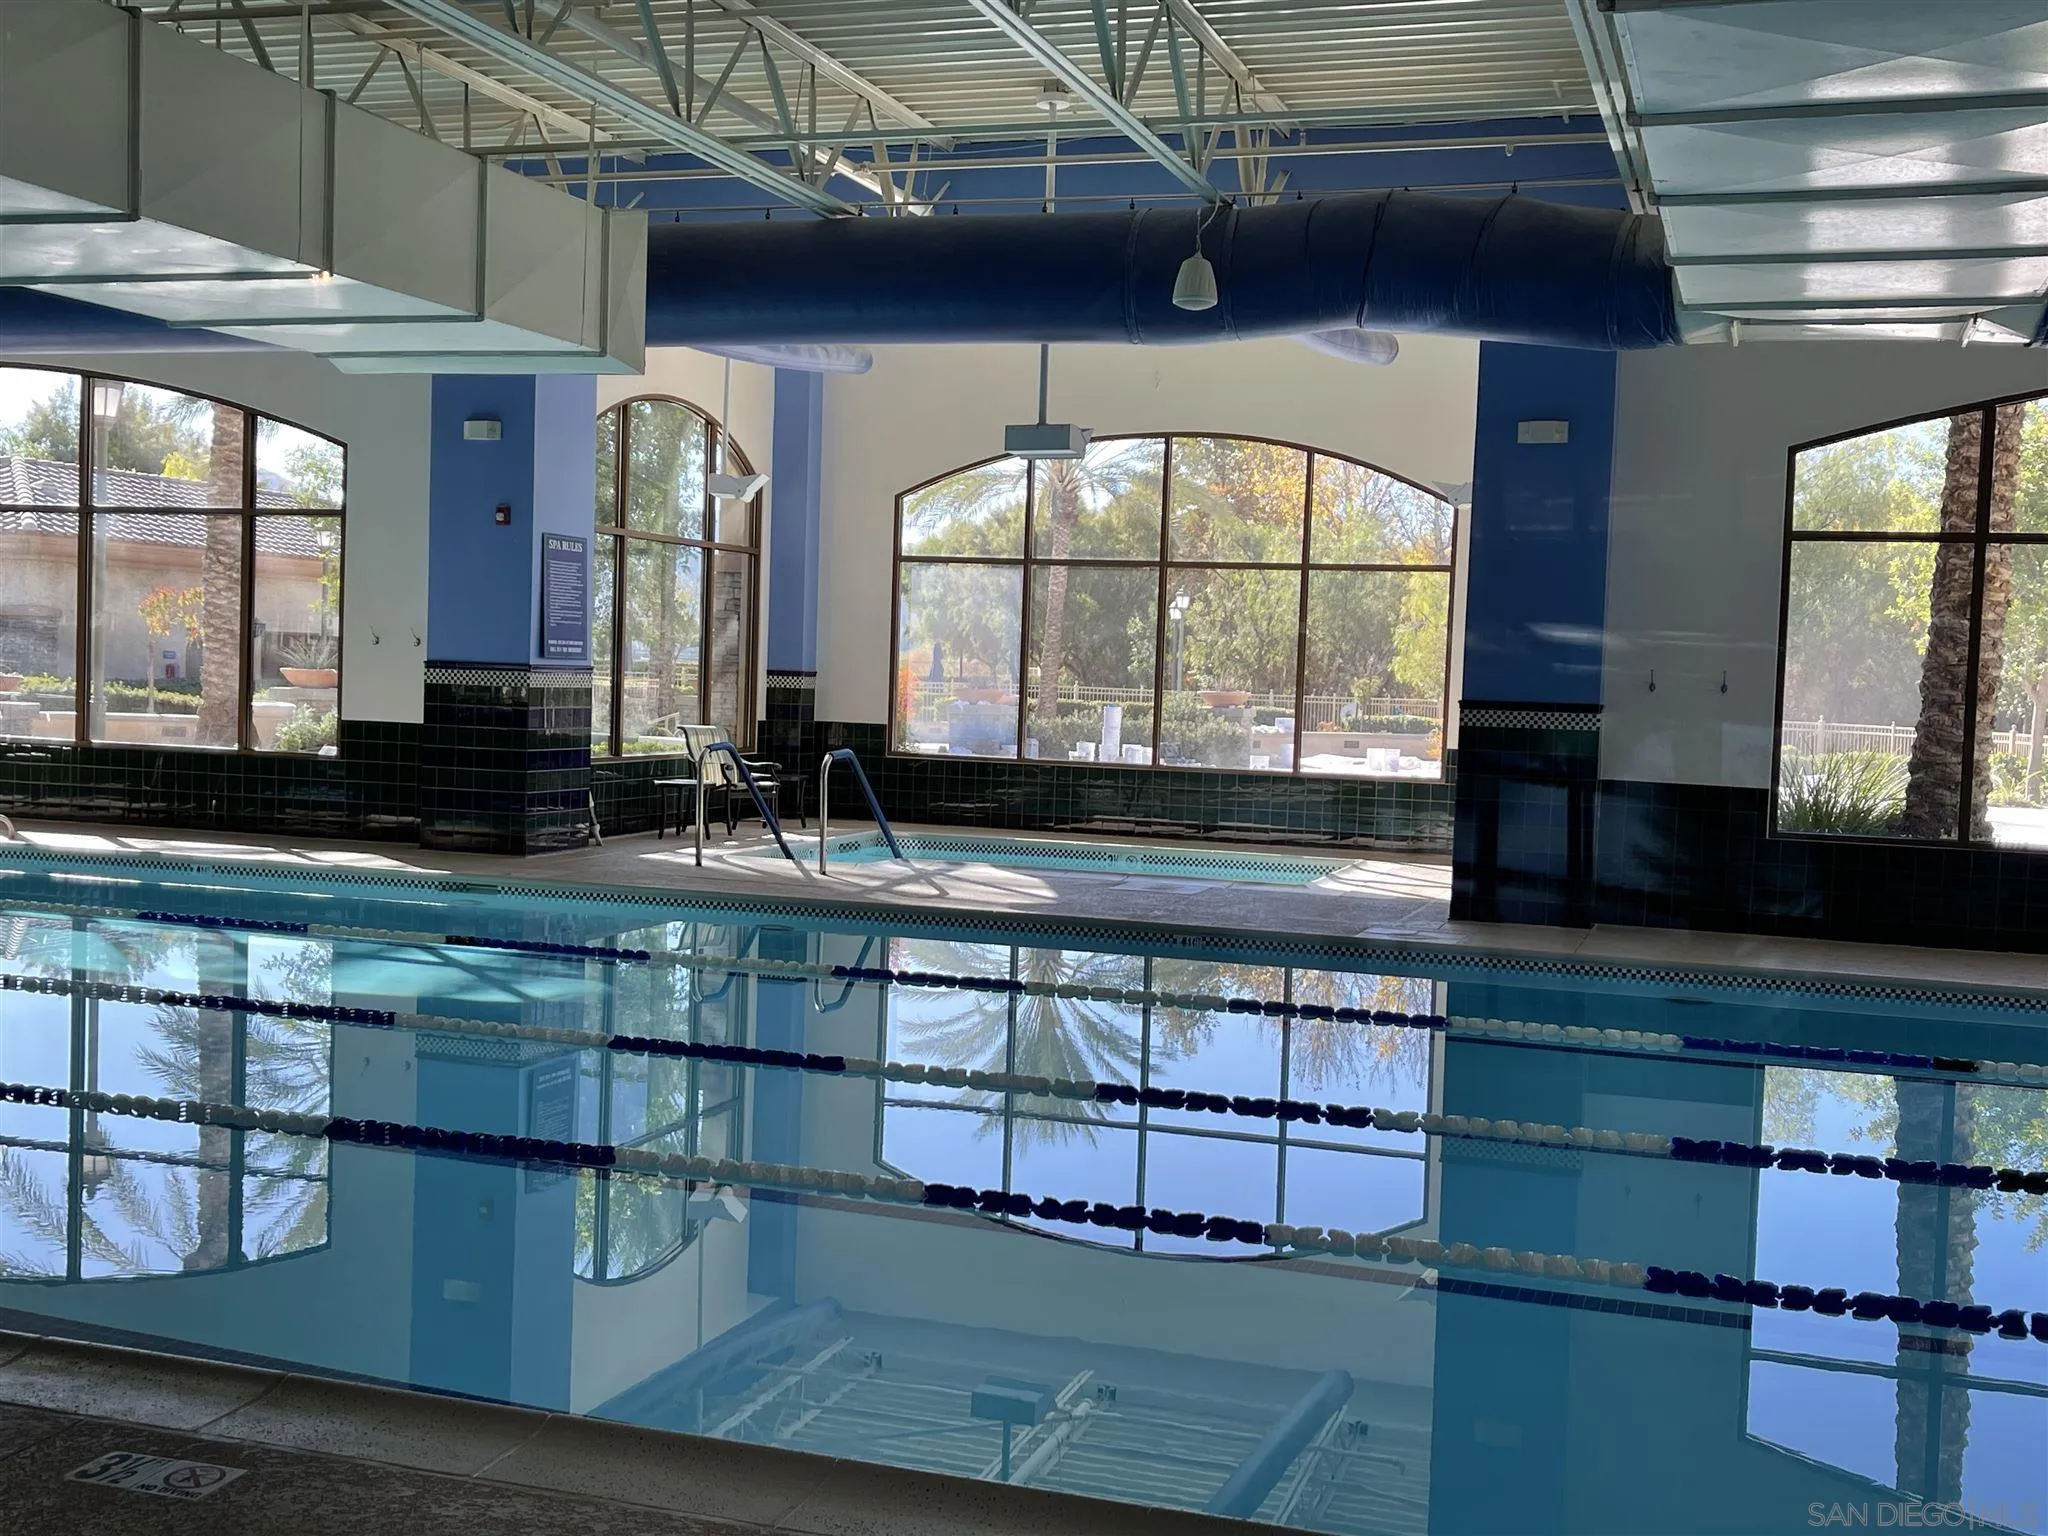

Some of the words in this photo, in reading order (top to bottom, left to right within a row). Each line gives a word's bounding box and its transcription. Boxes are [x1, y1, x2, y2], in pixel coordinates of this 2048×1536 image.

[549, 540, 561, 550] SPA
[562, 541, 583, 552] RULES
[159, 1485, 202, 1498] DIVING
